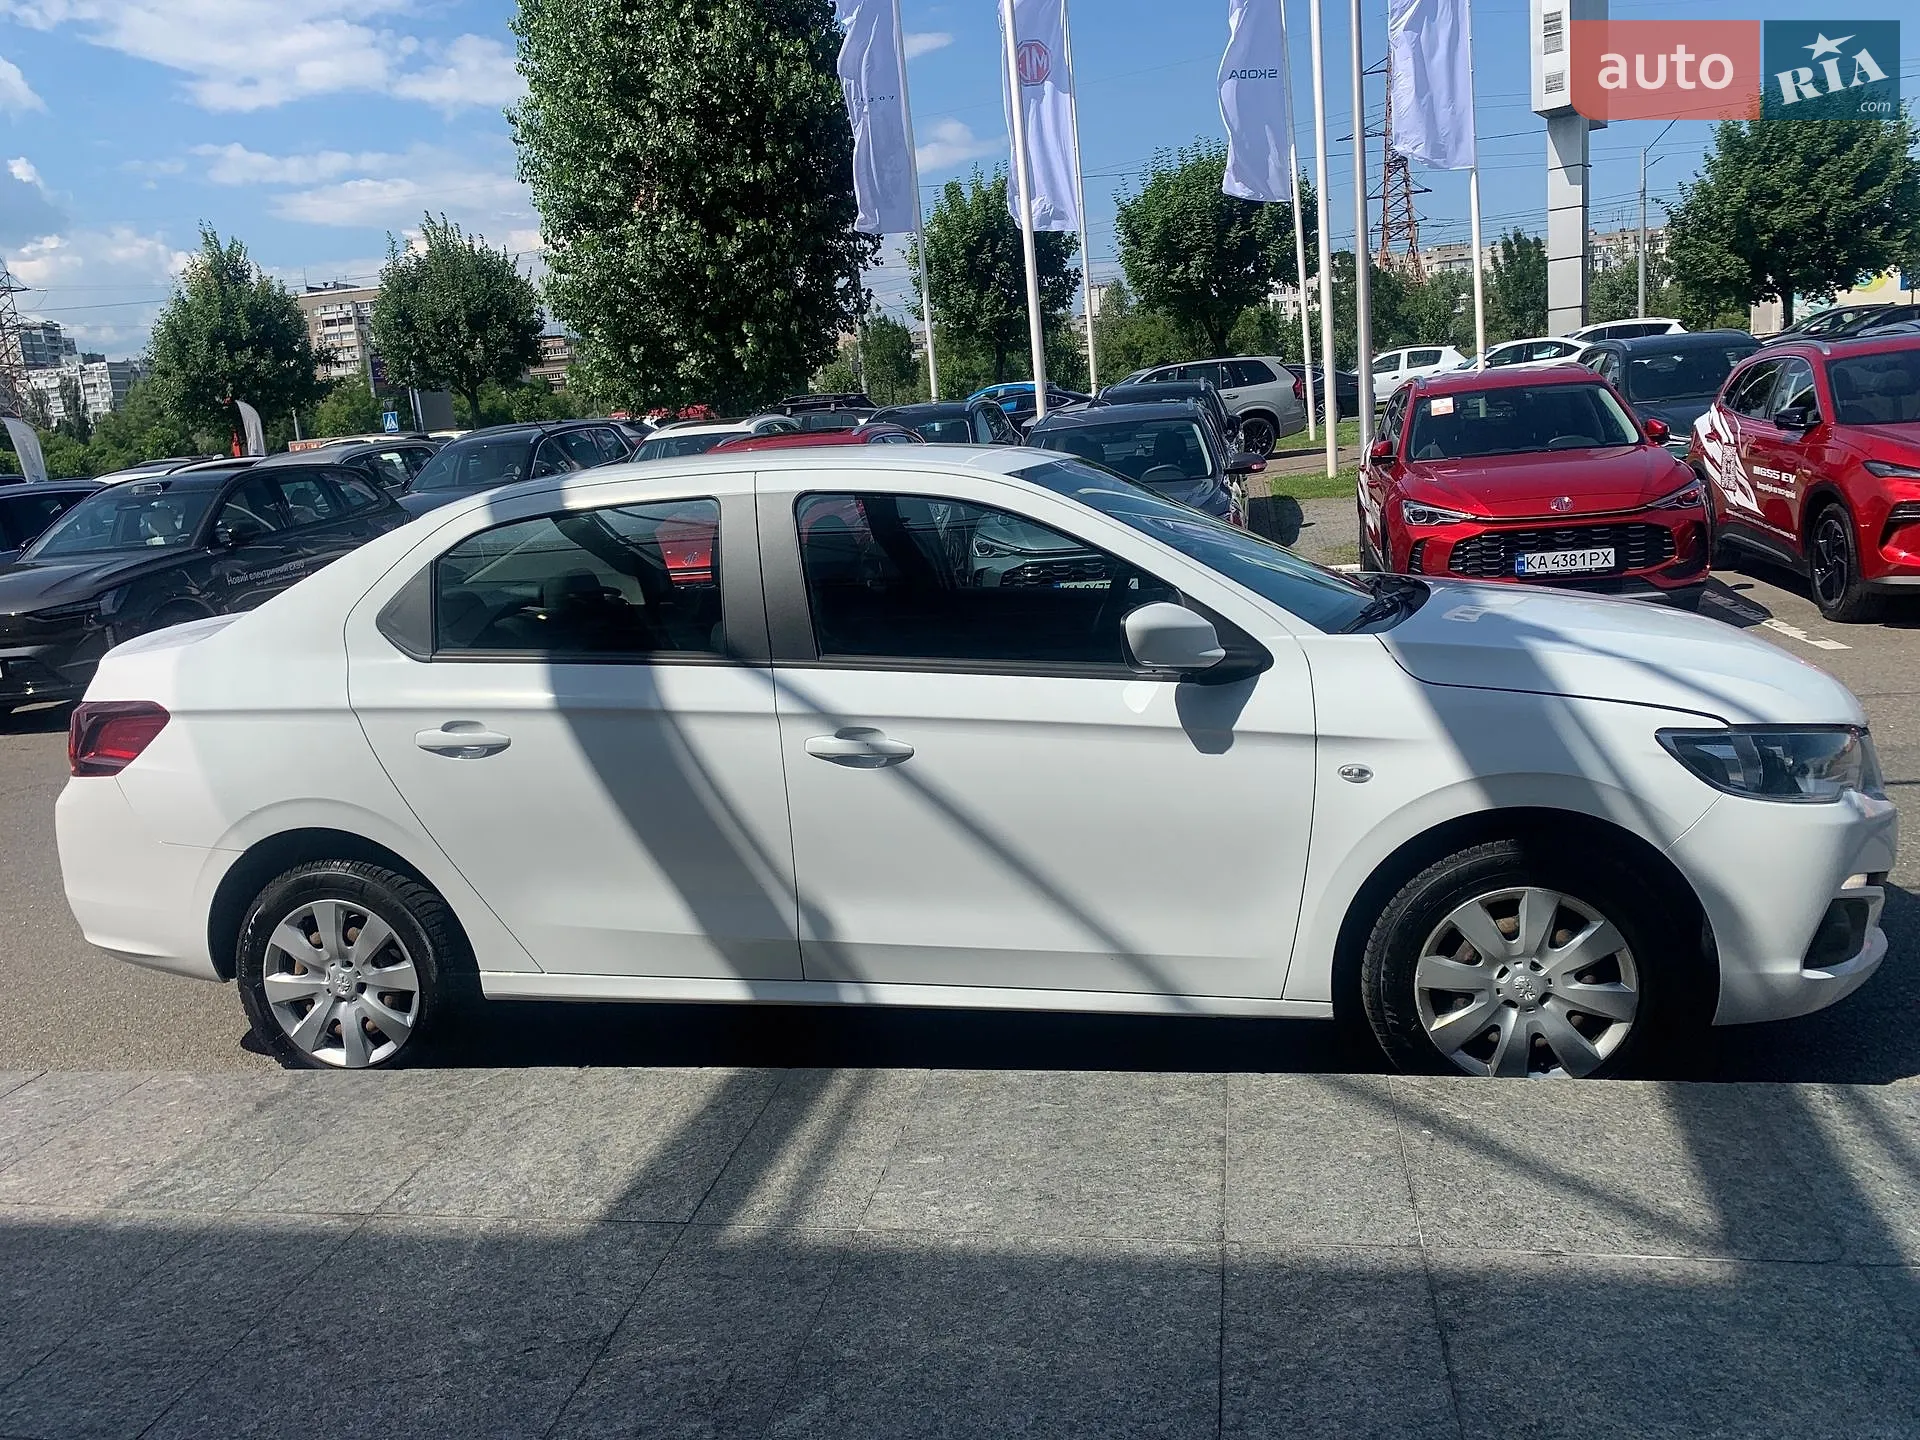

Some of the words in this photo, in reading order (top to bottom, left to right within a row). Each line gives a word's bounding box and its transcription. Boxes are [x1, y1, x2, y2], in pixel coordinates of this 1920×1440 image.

[1781, 472, 1797, 484] EV
[1526, 556, 1548, 570] KA
[1551, 552, 1586, 568] 4381
[1589, 551, 1611, 566] PX
[226, 571, 249, 586] Новий
